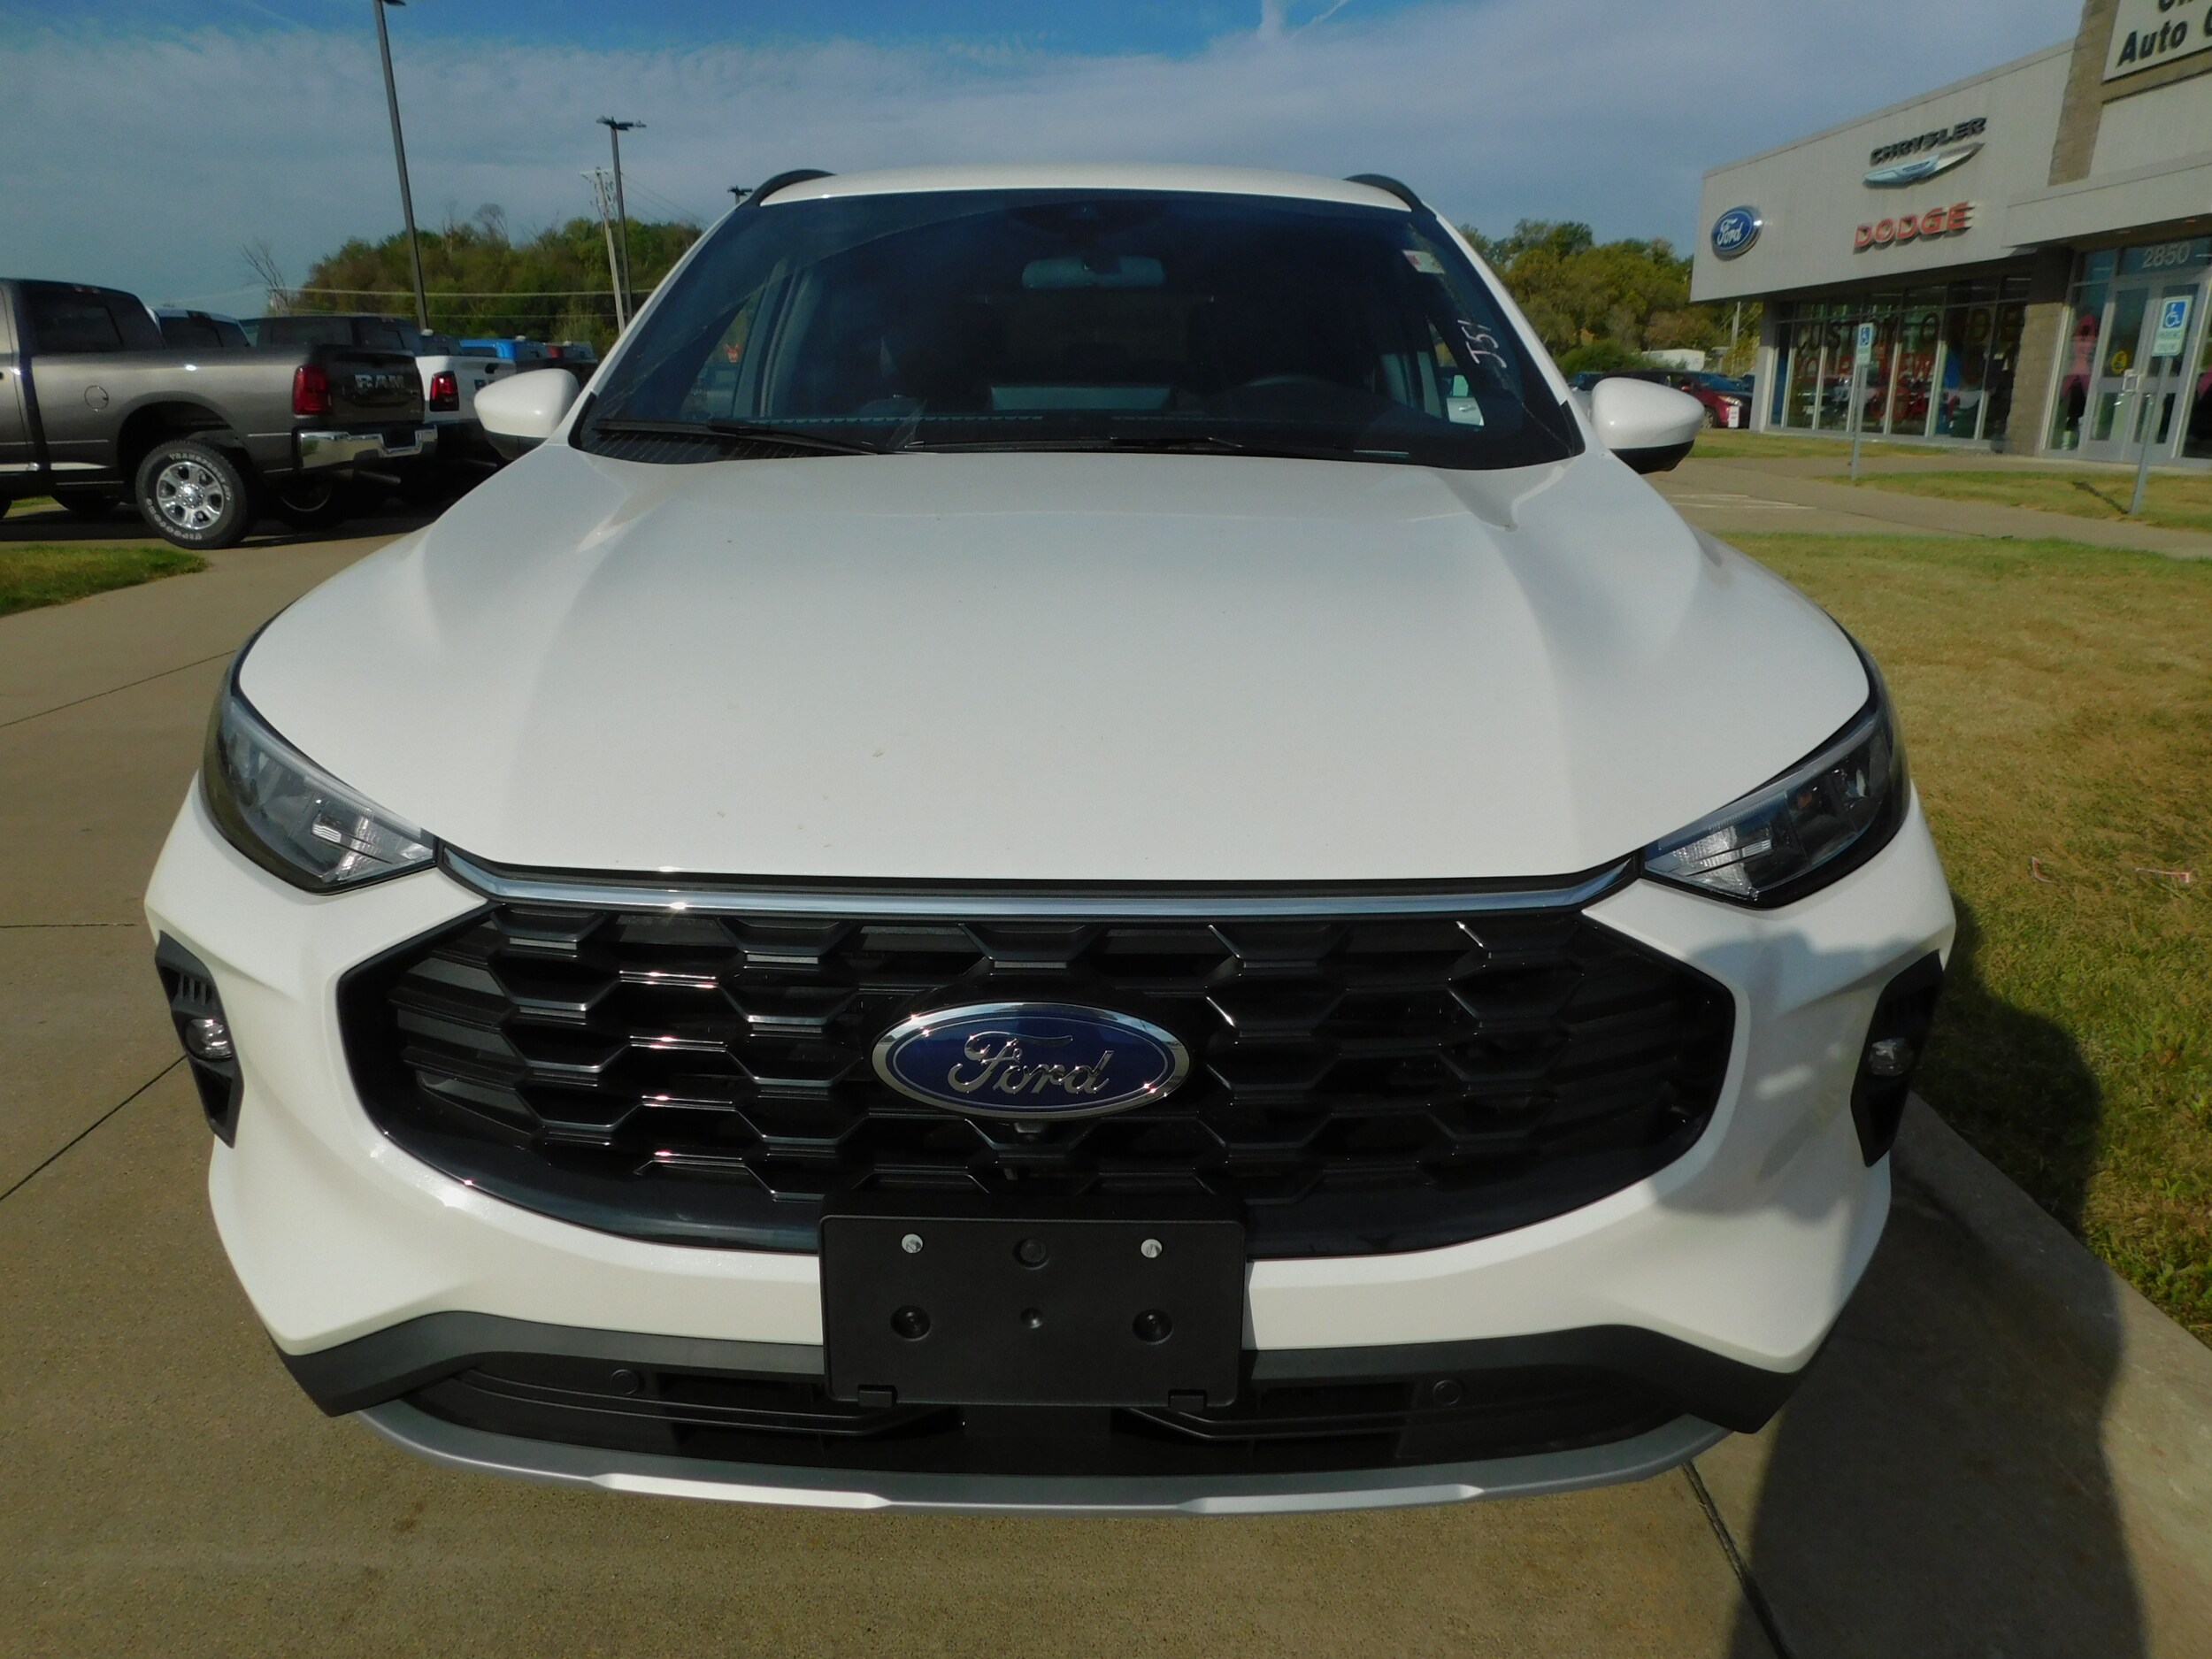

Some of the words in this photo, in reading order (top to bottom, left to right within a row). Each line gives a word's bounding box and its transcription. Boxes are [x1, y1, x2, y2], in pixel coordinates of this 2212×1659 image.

[2116, 19, 2188, 68] Auto
[1870, 117, 1987, 165] CHRYSLER
[1717, 217, 1745, 246] Ford
[1854, 201, 1974, 250] DODGE
[2141, 241, 2192, 269] 2850
[354, 373, 405, 389] RAM
[948, 1030, 1115, 1095] Ford
